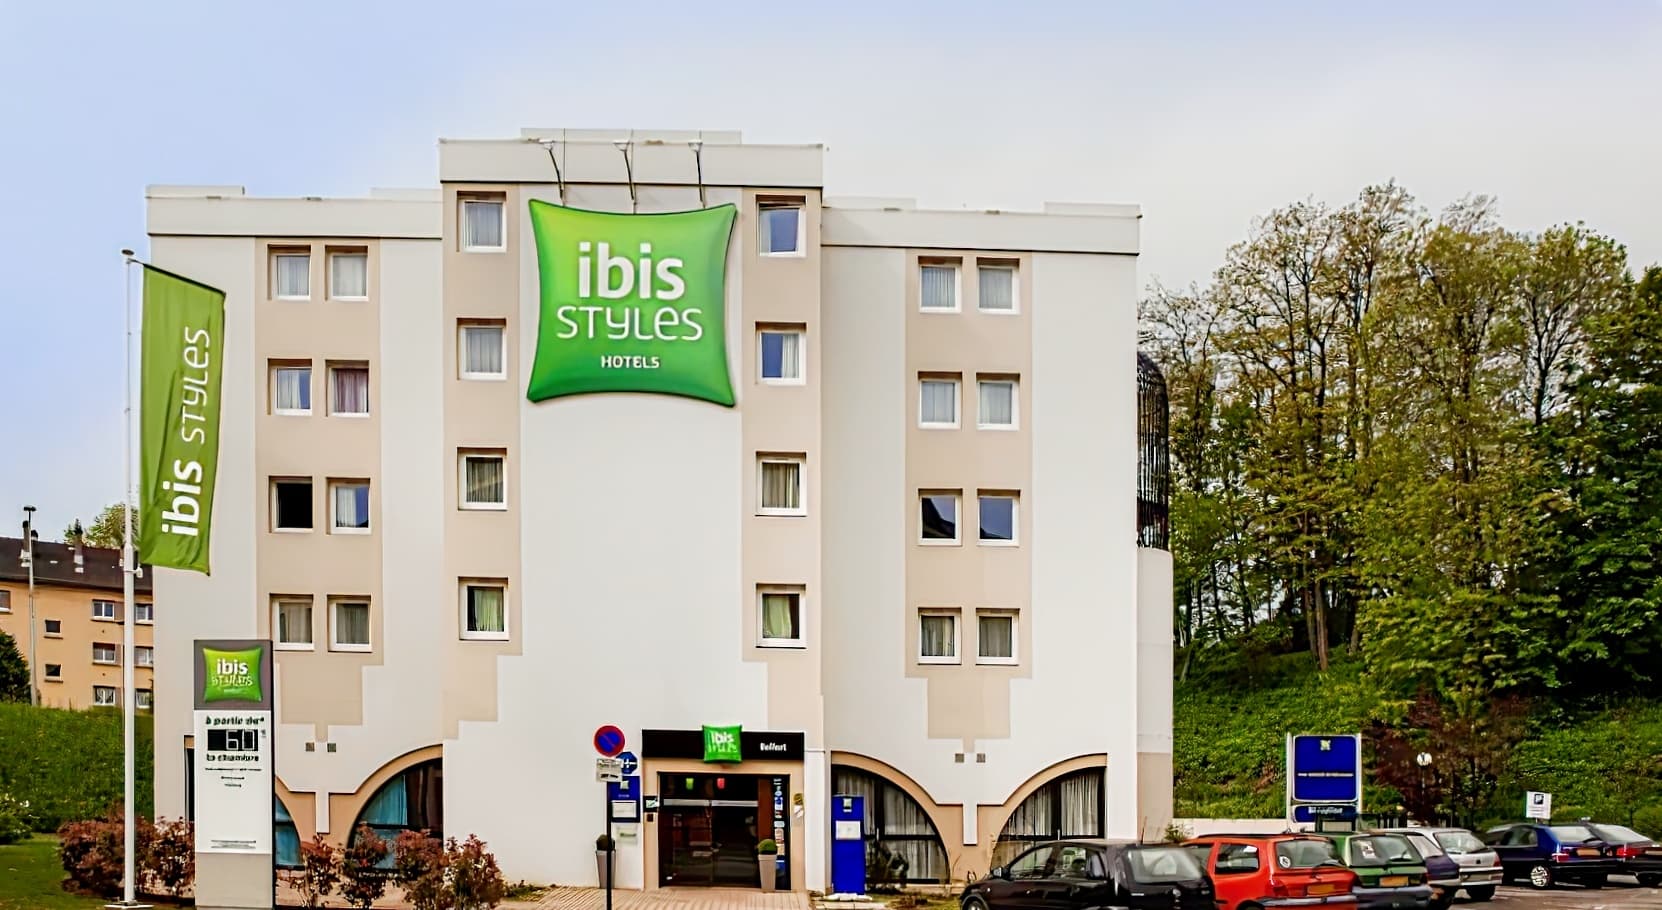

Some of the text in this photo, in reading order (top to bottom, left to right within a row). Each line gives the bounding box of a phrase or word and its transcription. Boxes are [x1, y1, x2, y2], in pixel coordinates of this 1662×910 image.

[578, 241, 686, 300] ibis
[600, 355, 660, 368] HOTELS
[161, 459, 204, 537] ibis
[216, 658, 248, 675] ibis
